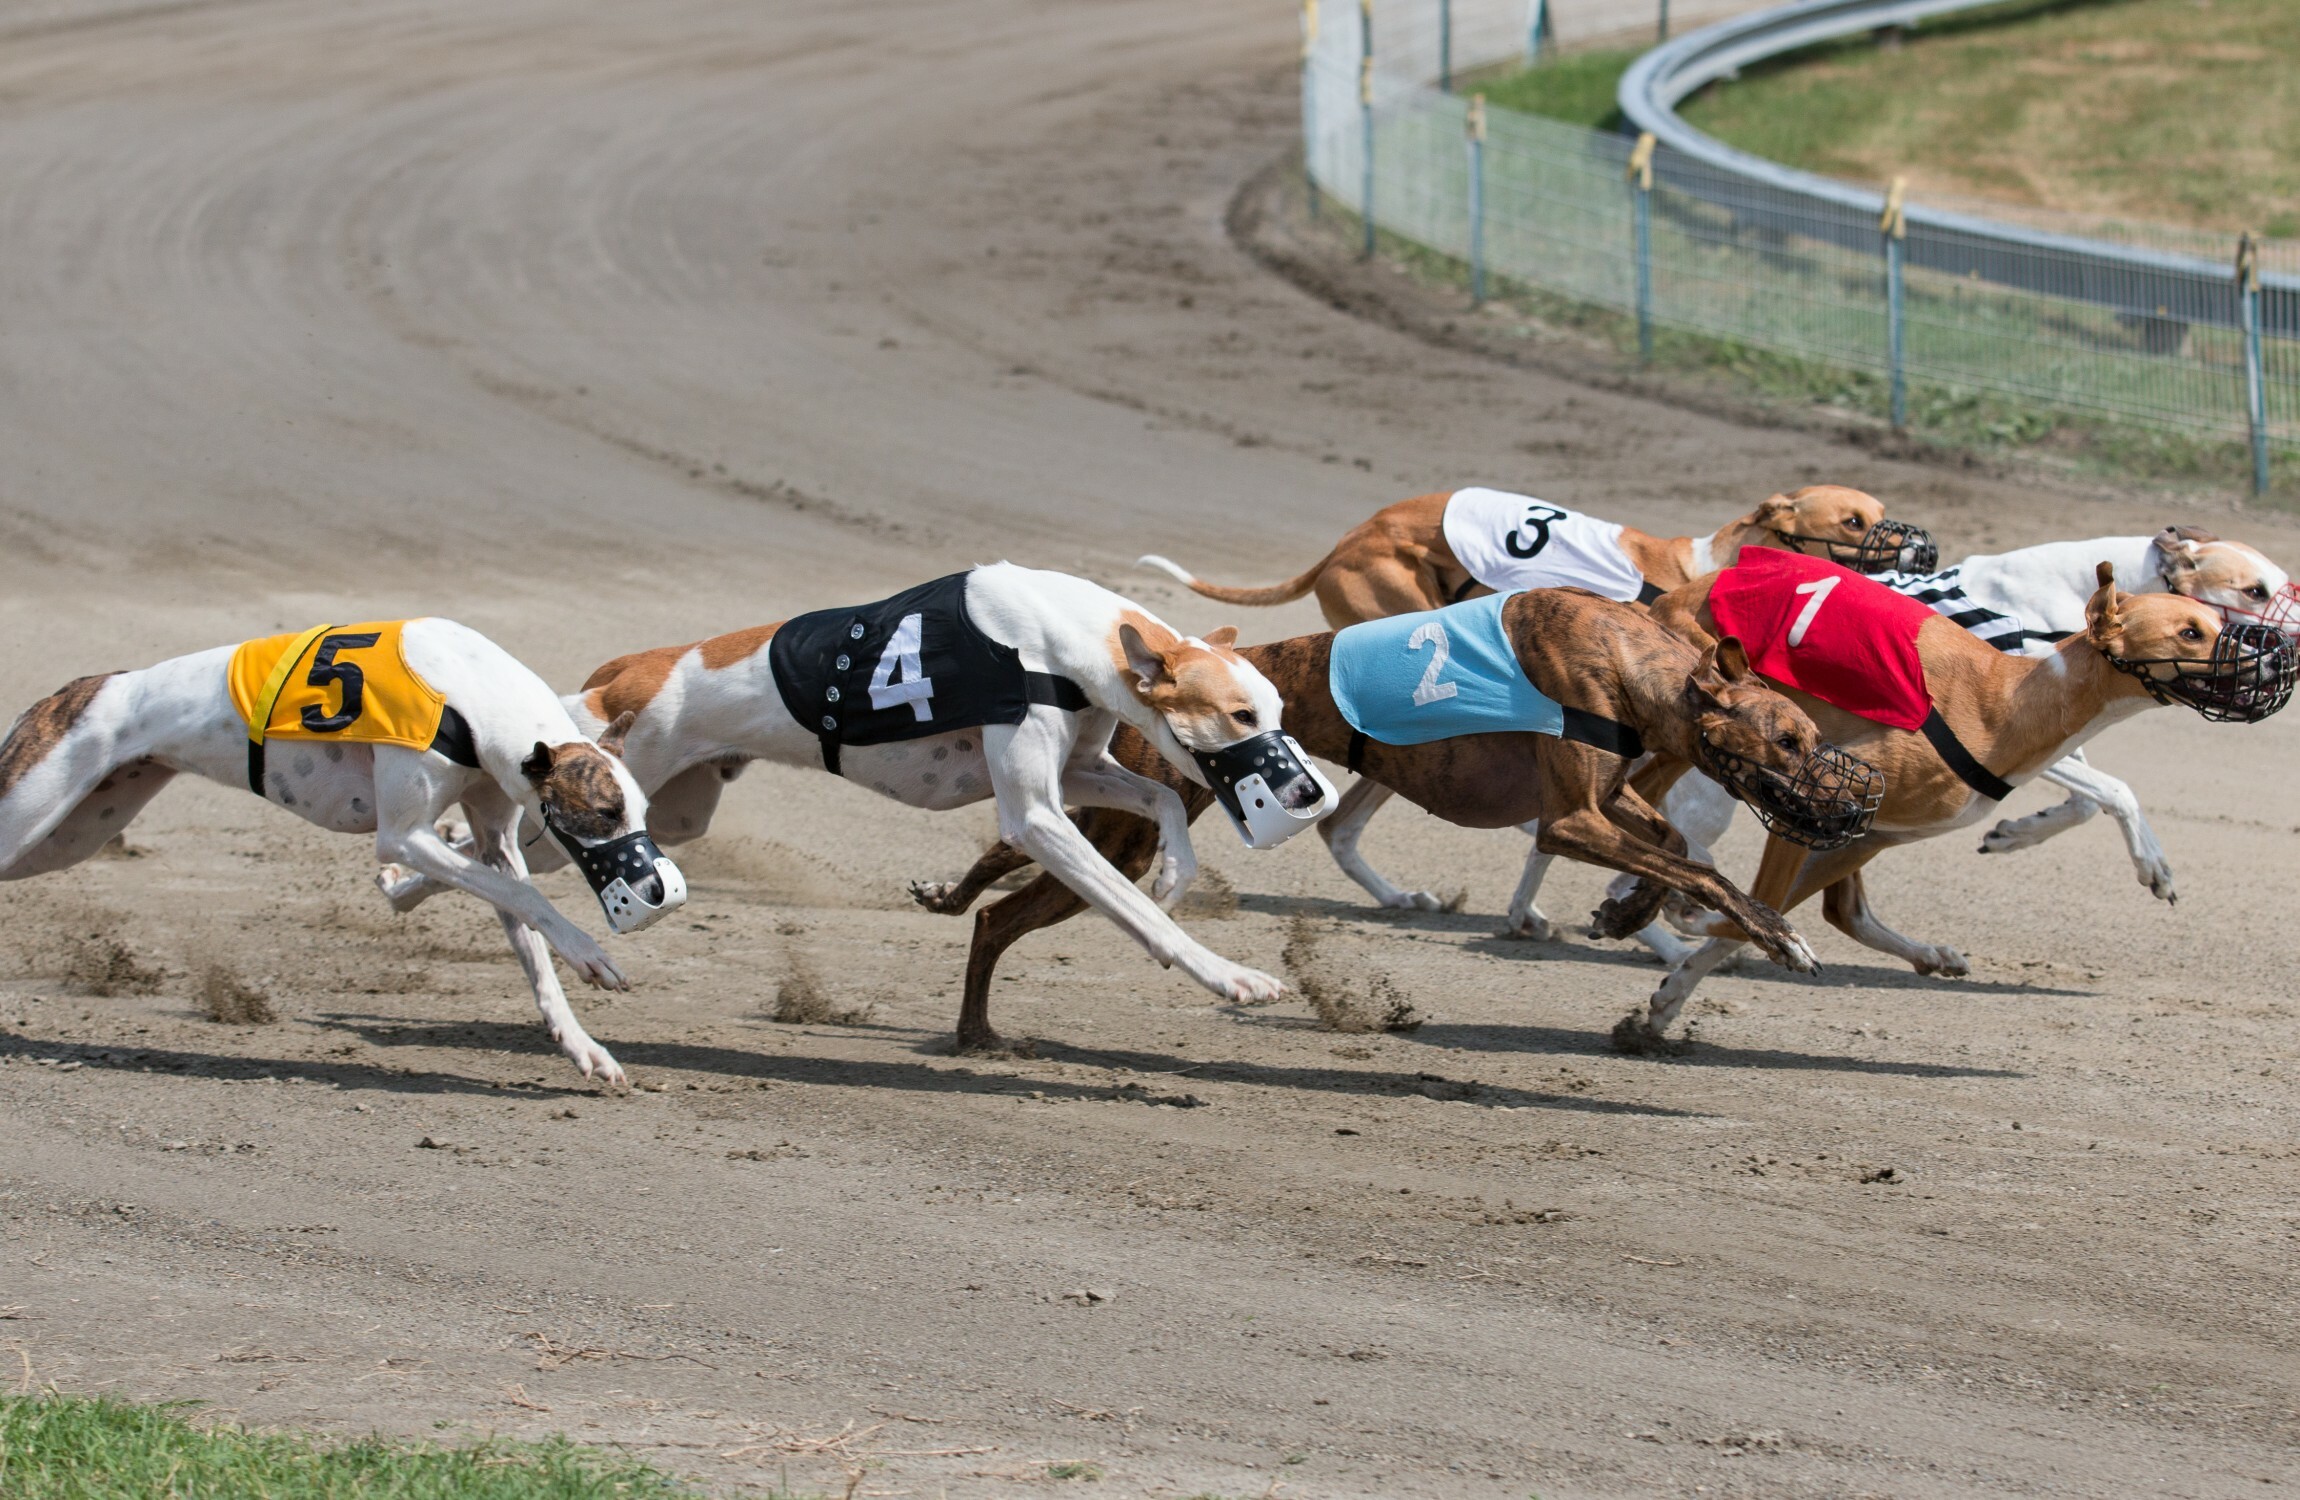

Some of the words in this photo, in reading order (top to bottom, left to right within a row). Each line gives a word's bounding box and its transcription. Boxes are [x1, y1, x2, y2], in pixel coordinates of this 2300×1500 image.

[1506, 506, 1567, 559] 3
[1788, 575, 1841, 647] 1
[300, 632, 381, 732] 5
[868, 613, 934, 721] 4
[1408, 622, 1457, 706] 2
